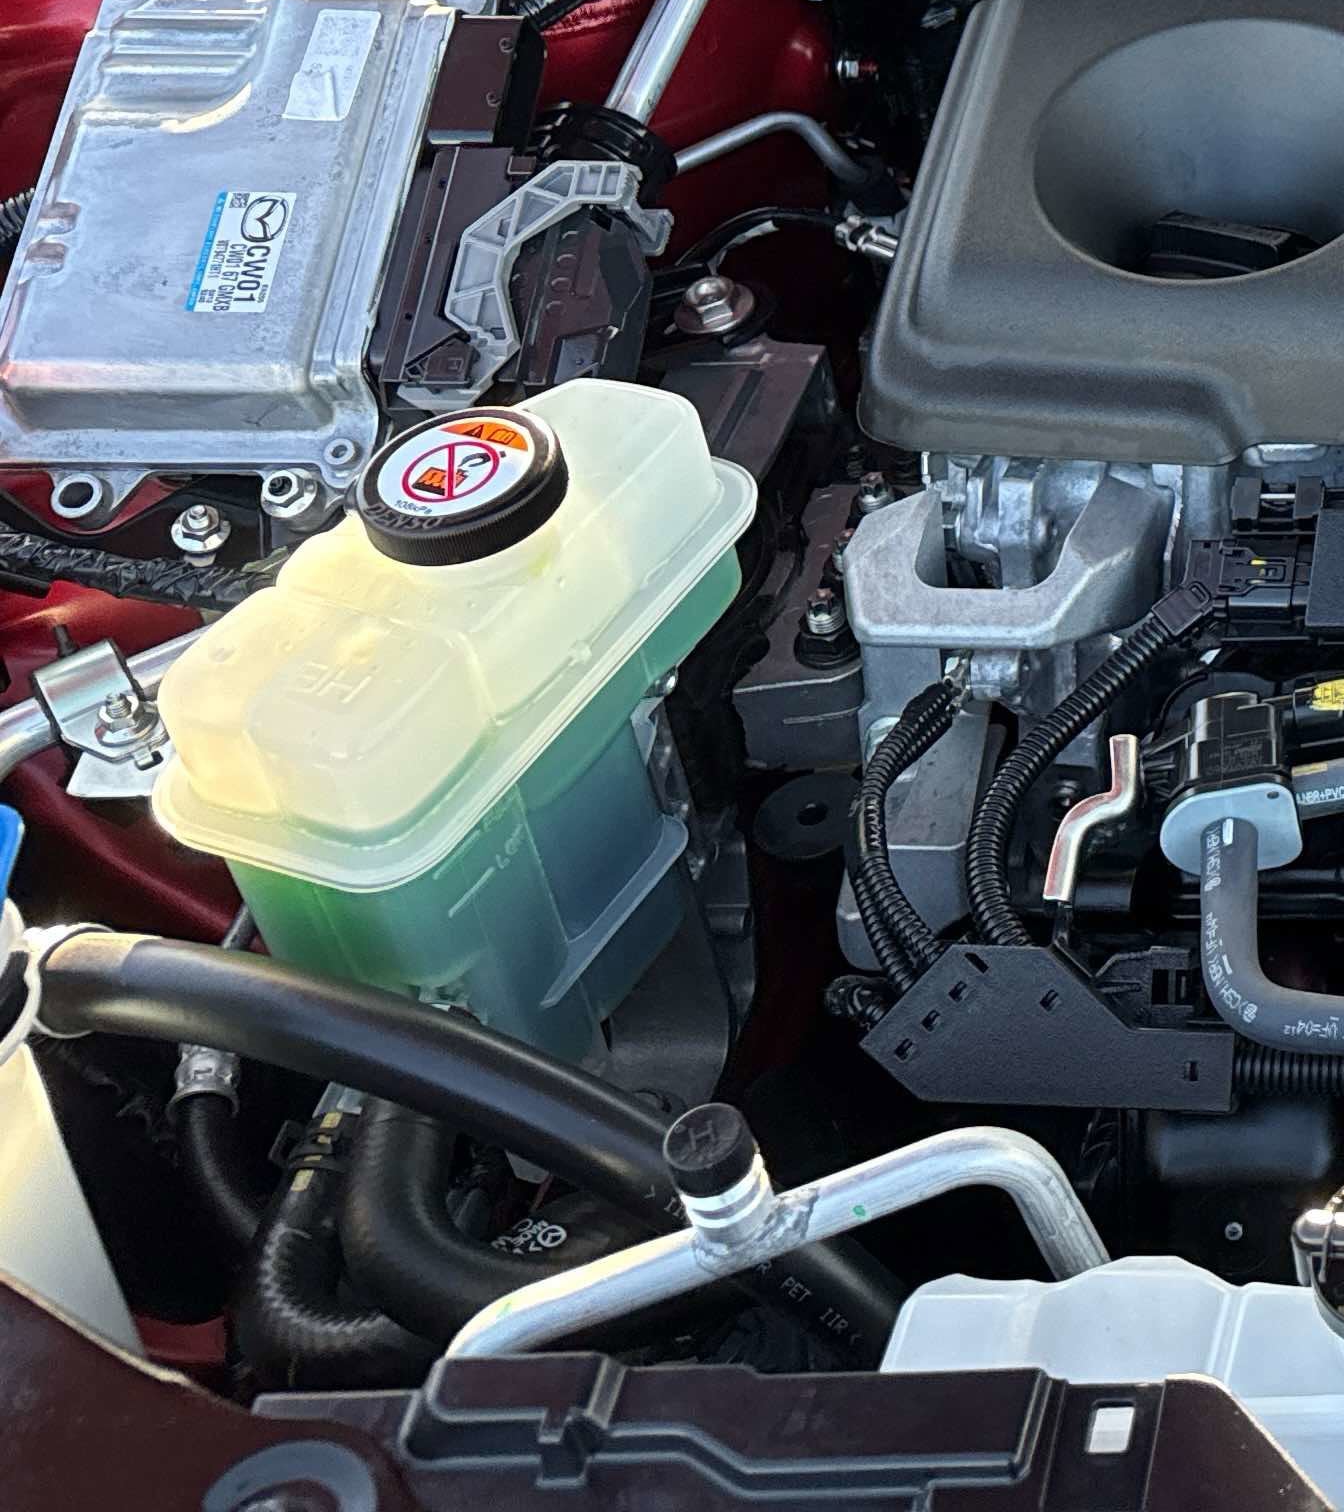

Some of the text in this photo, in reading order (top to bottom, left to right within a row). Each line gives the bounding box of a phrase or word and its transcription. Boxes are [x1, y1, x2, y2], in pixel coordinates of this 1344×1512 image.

[224, 242, 248, 269] CW01
[220, 271, 239, 282] 67
[232, 245, 271, 303] CW01
[212, 285, 236, 312] GMXB
[363, 503, 443, 530] DENSO
[510, 1219, 550, 1248] MADE
[780, 1276, 812, 1307] PET
